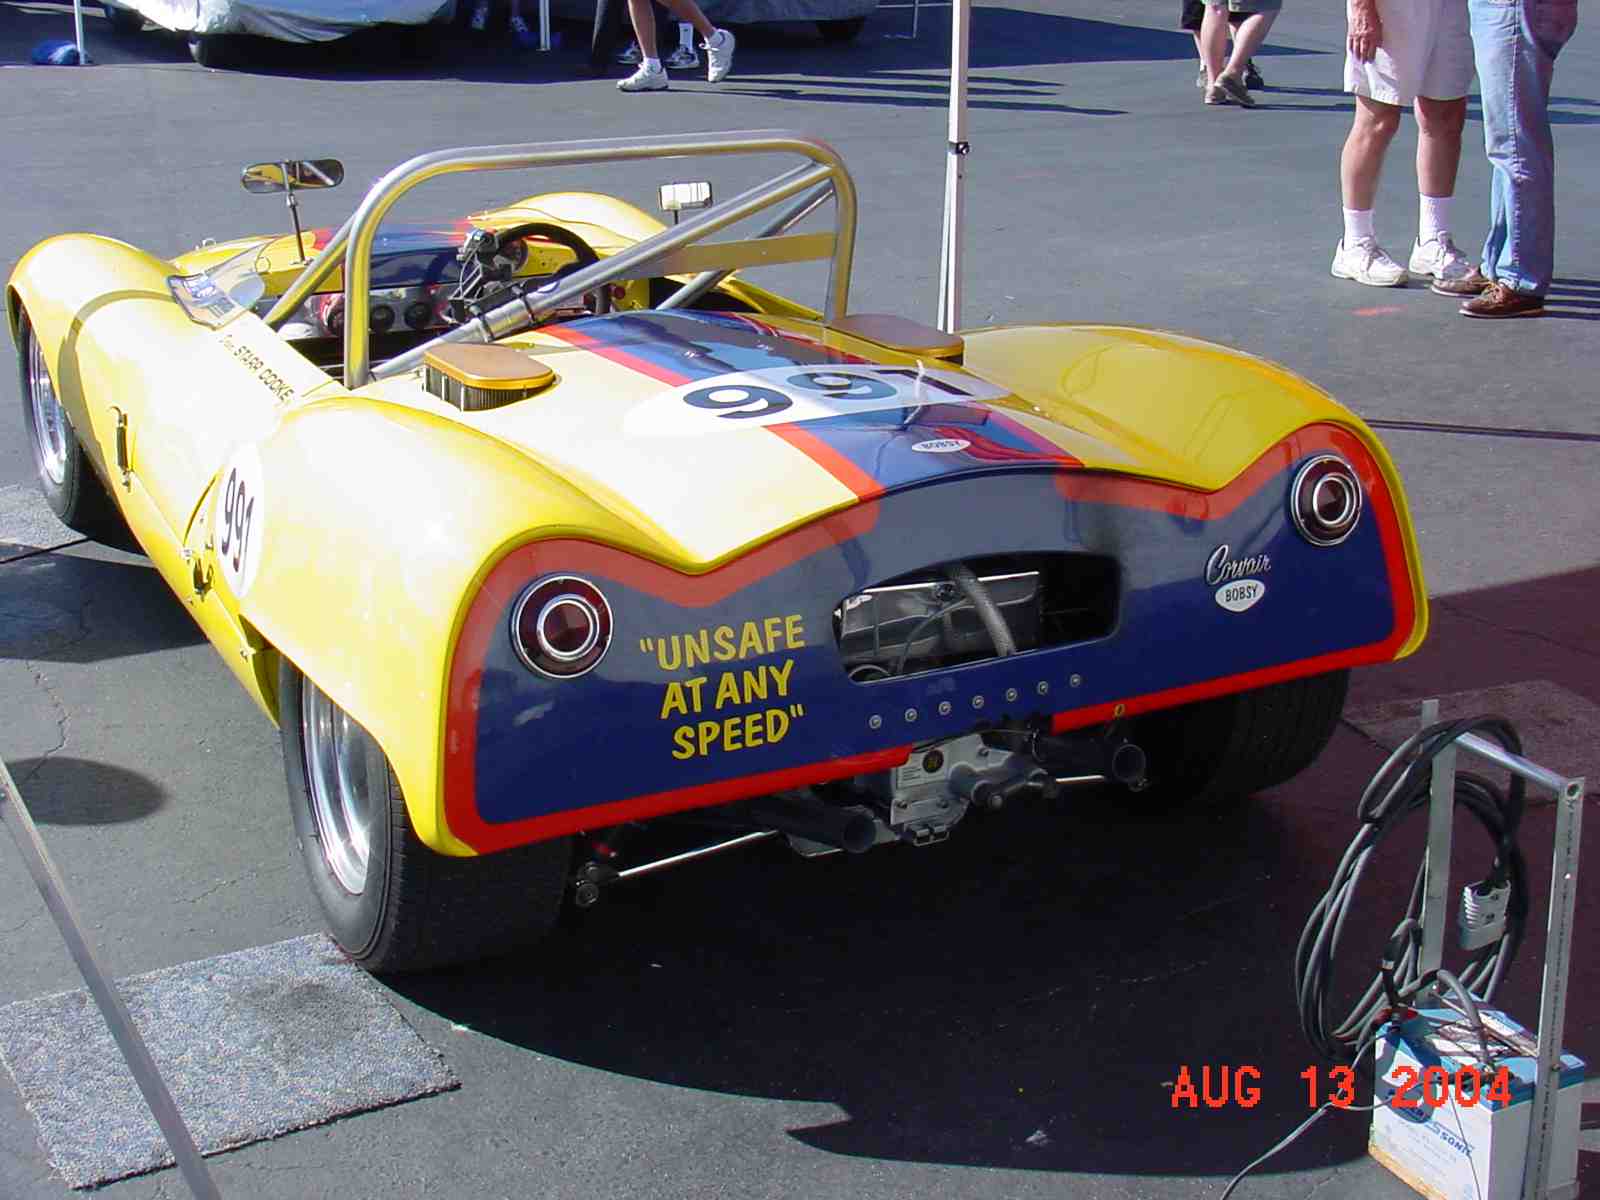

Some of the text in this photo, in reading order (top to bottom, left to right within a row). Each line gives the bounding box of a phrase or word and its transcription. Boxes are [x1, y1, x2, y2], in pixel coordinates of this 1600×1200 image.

[258, 368, 294, 401] COOKE
[221, 467, 254, 580] 991
[1206, 544, 1272, 585] Corvair
[1225, 584, 1258, 602] BOBSY
[639, 614, 806, 671] "UNSAFE
[660, 659, 794, 719] AT ANY
[671, 703, 804, 760] SPEED"
